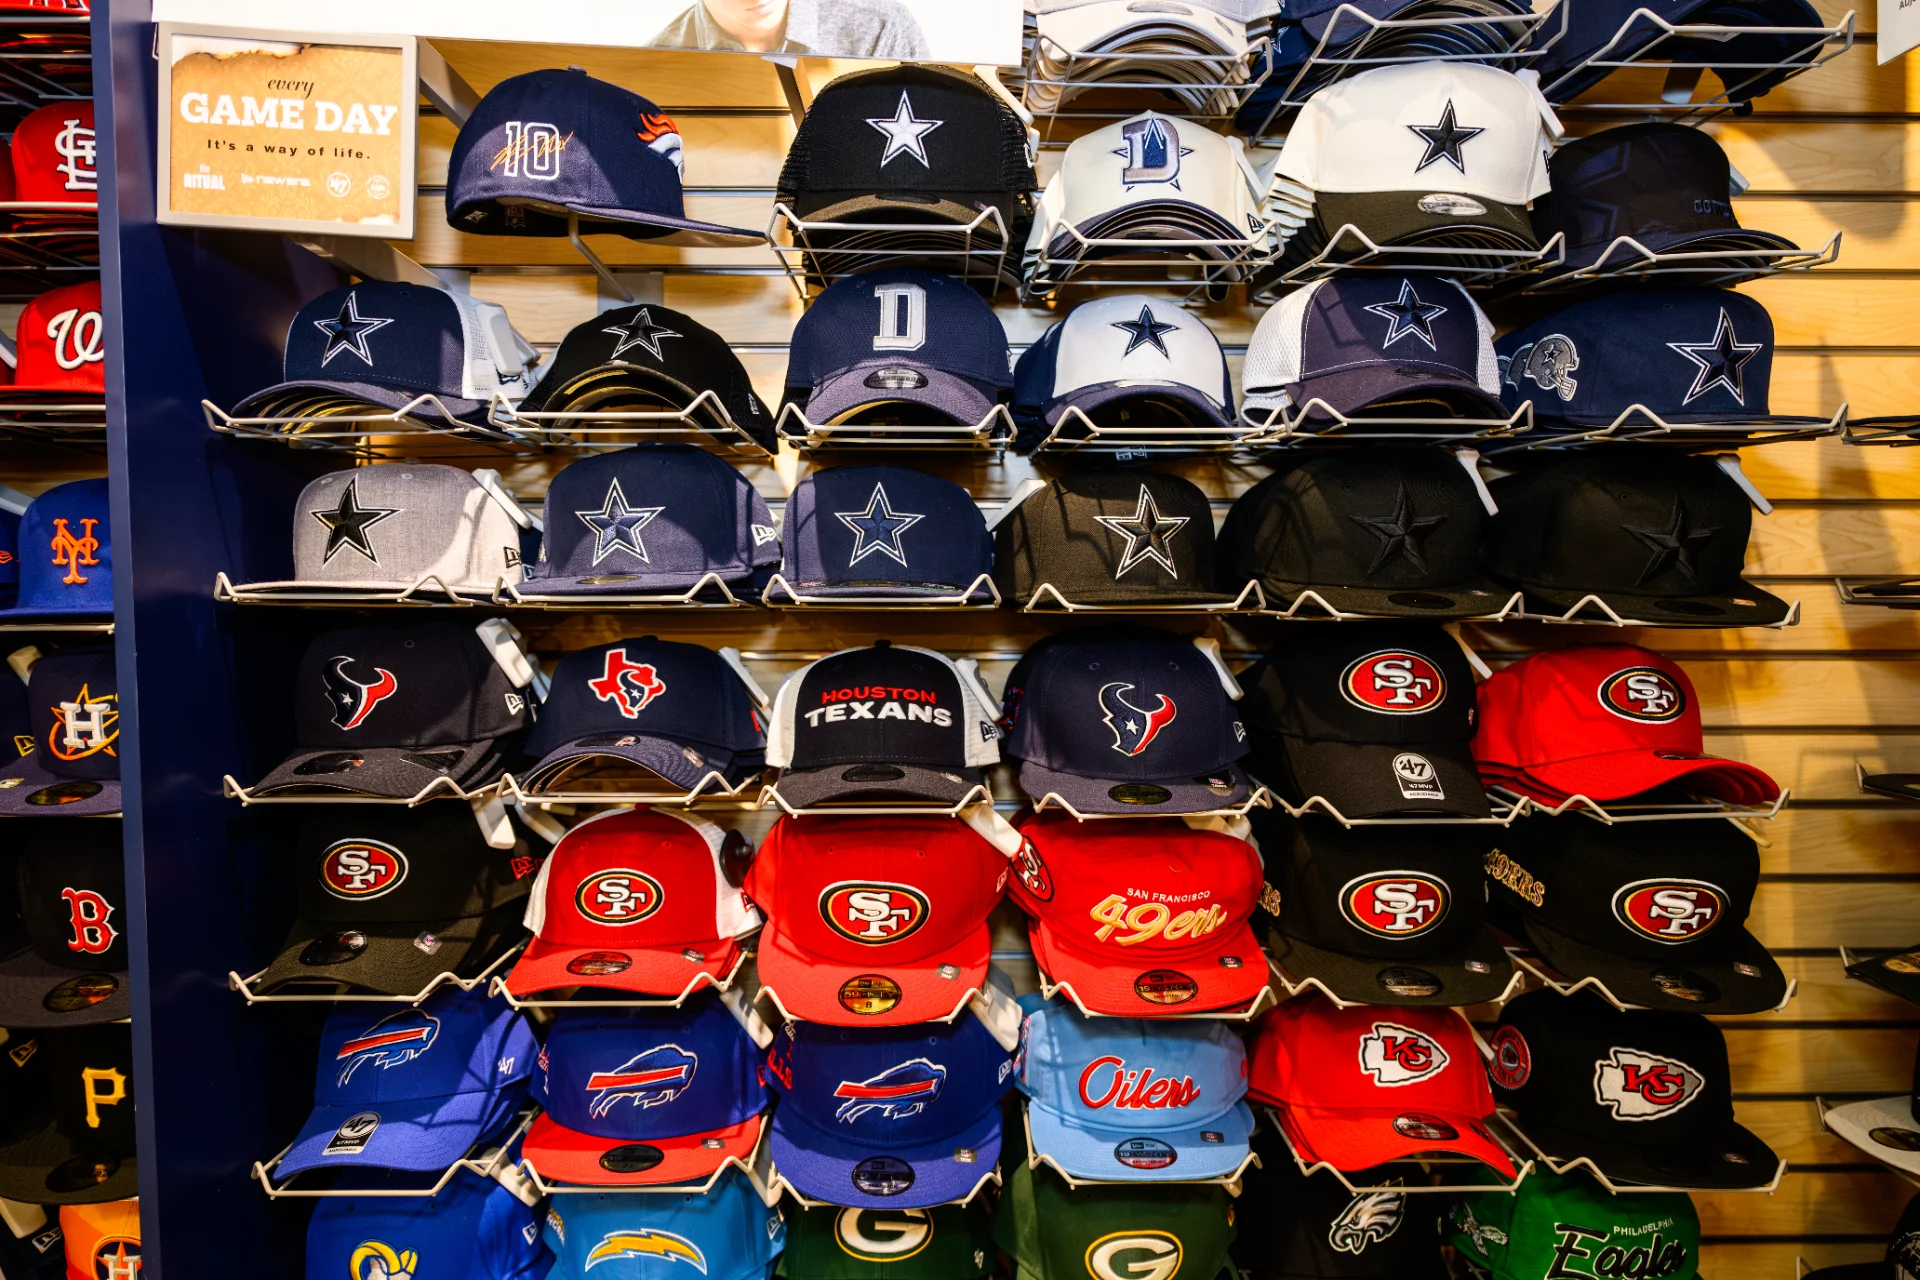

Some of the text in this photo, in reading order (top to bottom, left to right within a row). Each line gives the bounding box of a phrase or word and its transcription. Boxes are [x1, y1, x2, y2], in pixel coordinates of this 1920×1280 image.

[267, 76, 315, 99] every
[179, 92, 398, 136] GAME DAY
[206, 138, 371, 161] It's a way of life.
[504, 121, 560, 181] 10
[1122, 118, 1180, 186] D
[183, 173, 226, 190] RITUAL
[873, 283, 927, 351] D
[821, 686, 937, 706] HOUSTON
[1373, 659, 1432, 705] SF
[1626, 675, 1674, 713] SF
[60, 700, 111, 749] H
[804, 701, 953, 728] TEXANS
[336, 849, 387, 889] SF
[596, 878, 646, 916] SF
[848, 890, 910, 937] SF
[1126, 887, 1211, 904] SAN FRANCISCO
[1373, 882, 1435, 930] SF
[1649, 889, 1713, 935] SF
[61, 886, 120, 955] B
[1090, 893, 1228, 946] 49ers
[1382, 1036, 1433, 1072] KC
[81, 1066, 126, 1128] P
[1078, 1055, 1201, 1110] Oilers
[1622, 1064, 1685, 1106] KC
[840, 1206, 928, 1253] G
[1613, 1217, 1675, 1236] PHILADELPHIA
[1092, 1237, 1178, 1280] G
